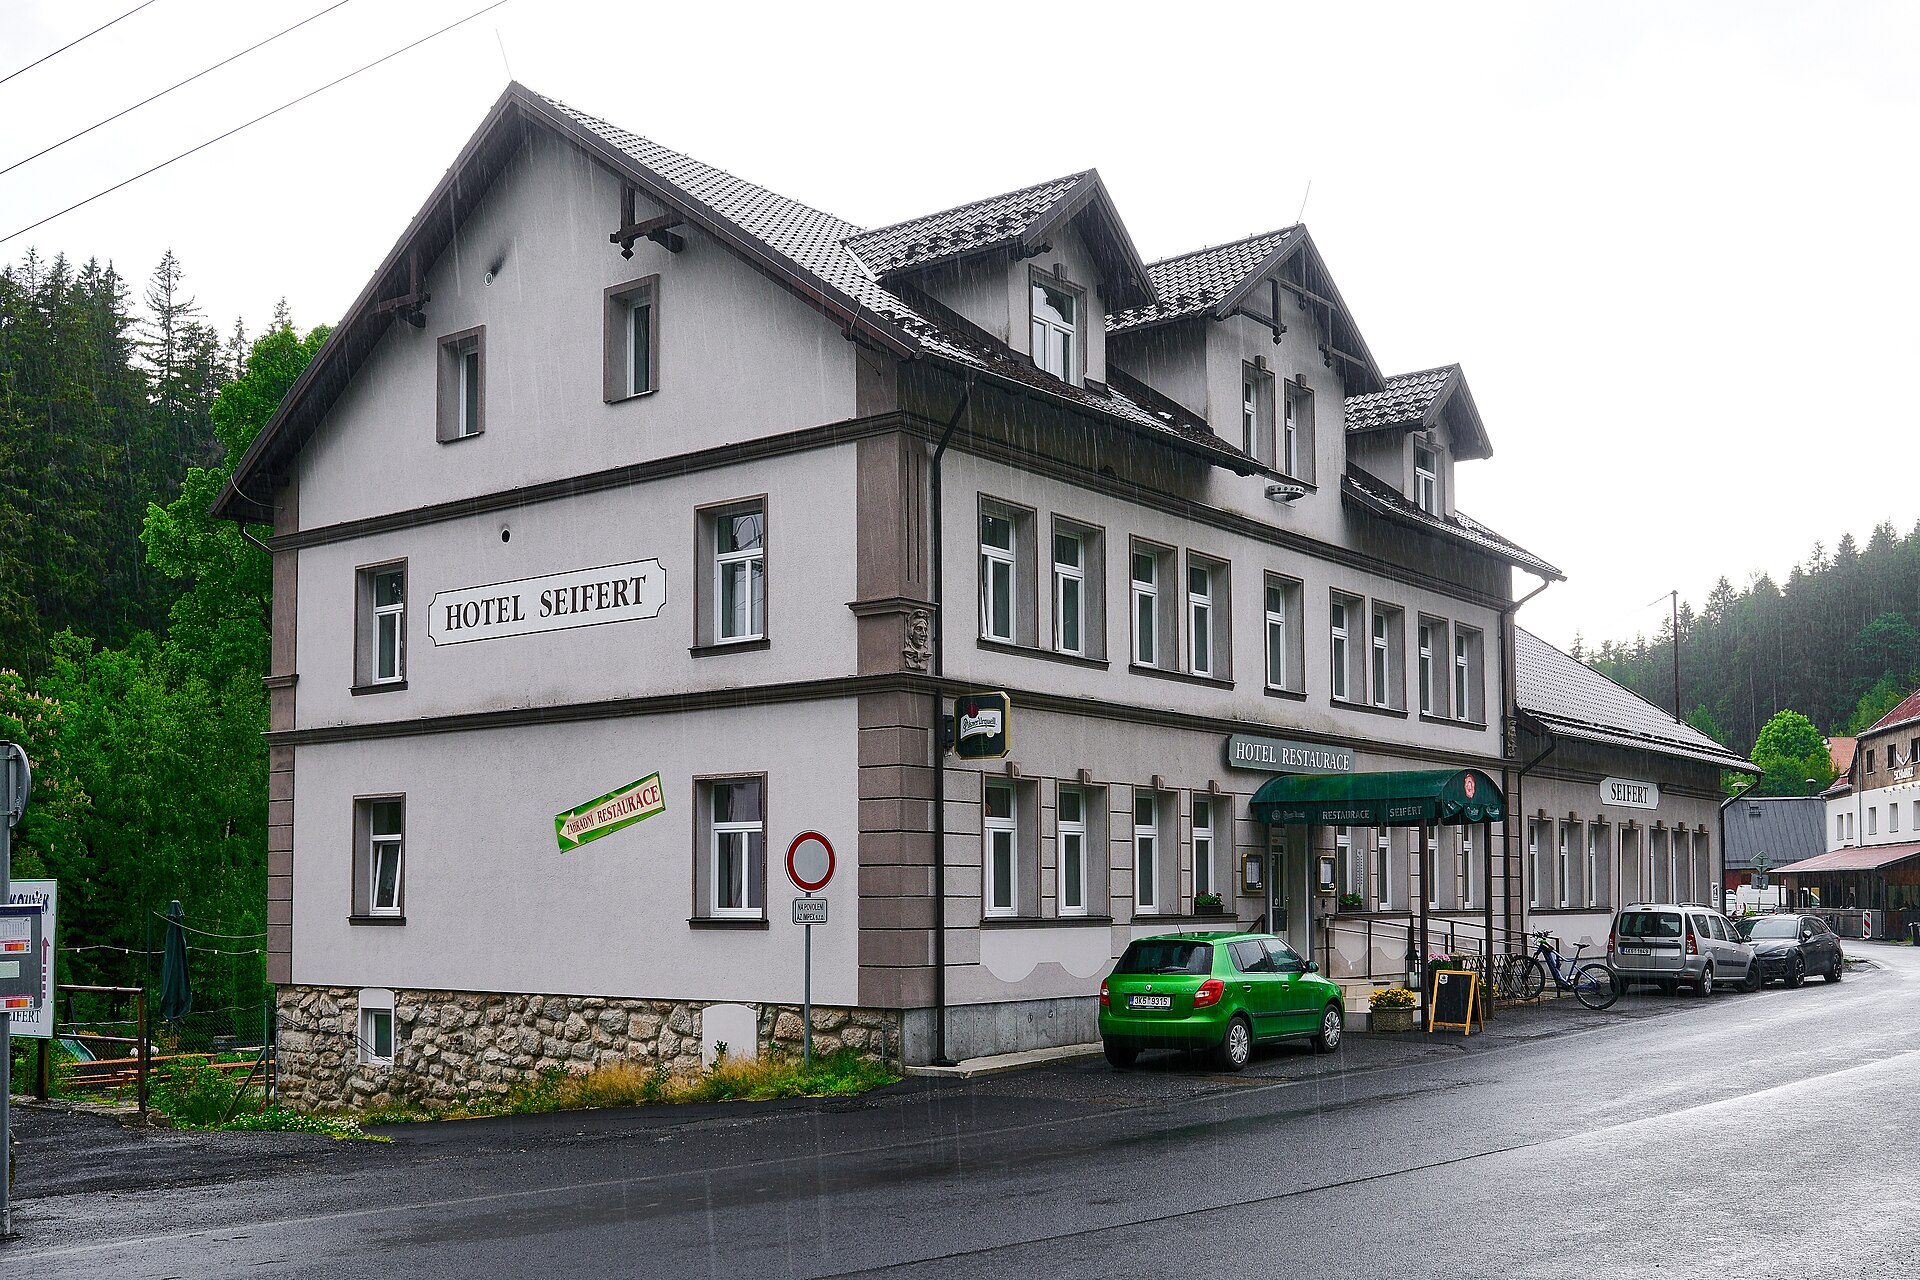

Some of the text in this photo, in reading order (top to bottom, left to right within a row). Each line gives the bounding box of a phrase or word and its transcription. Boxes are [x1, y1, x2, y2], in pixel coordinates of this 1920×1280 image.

[445, 575, 646, 631] HOTEL SEIFERT
[1236, 742, 1350, 771] HOTEL RESTAURACE
[1611, 782, 1649, 804] SEIFERT
[567, 785, 660, 835] ZAHRADNÍ RESTAURACE
[1322, 805, 1423, 820] RESTAURACE SEIFERT
[9, 1010, 41, 1023] EIFERT
